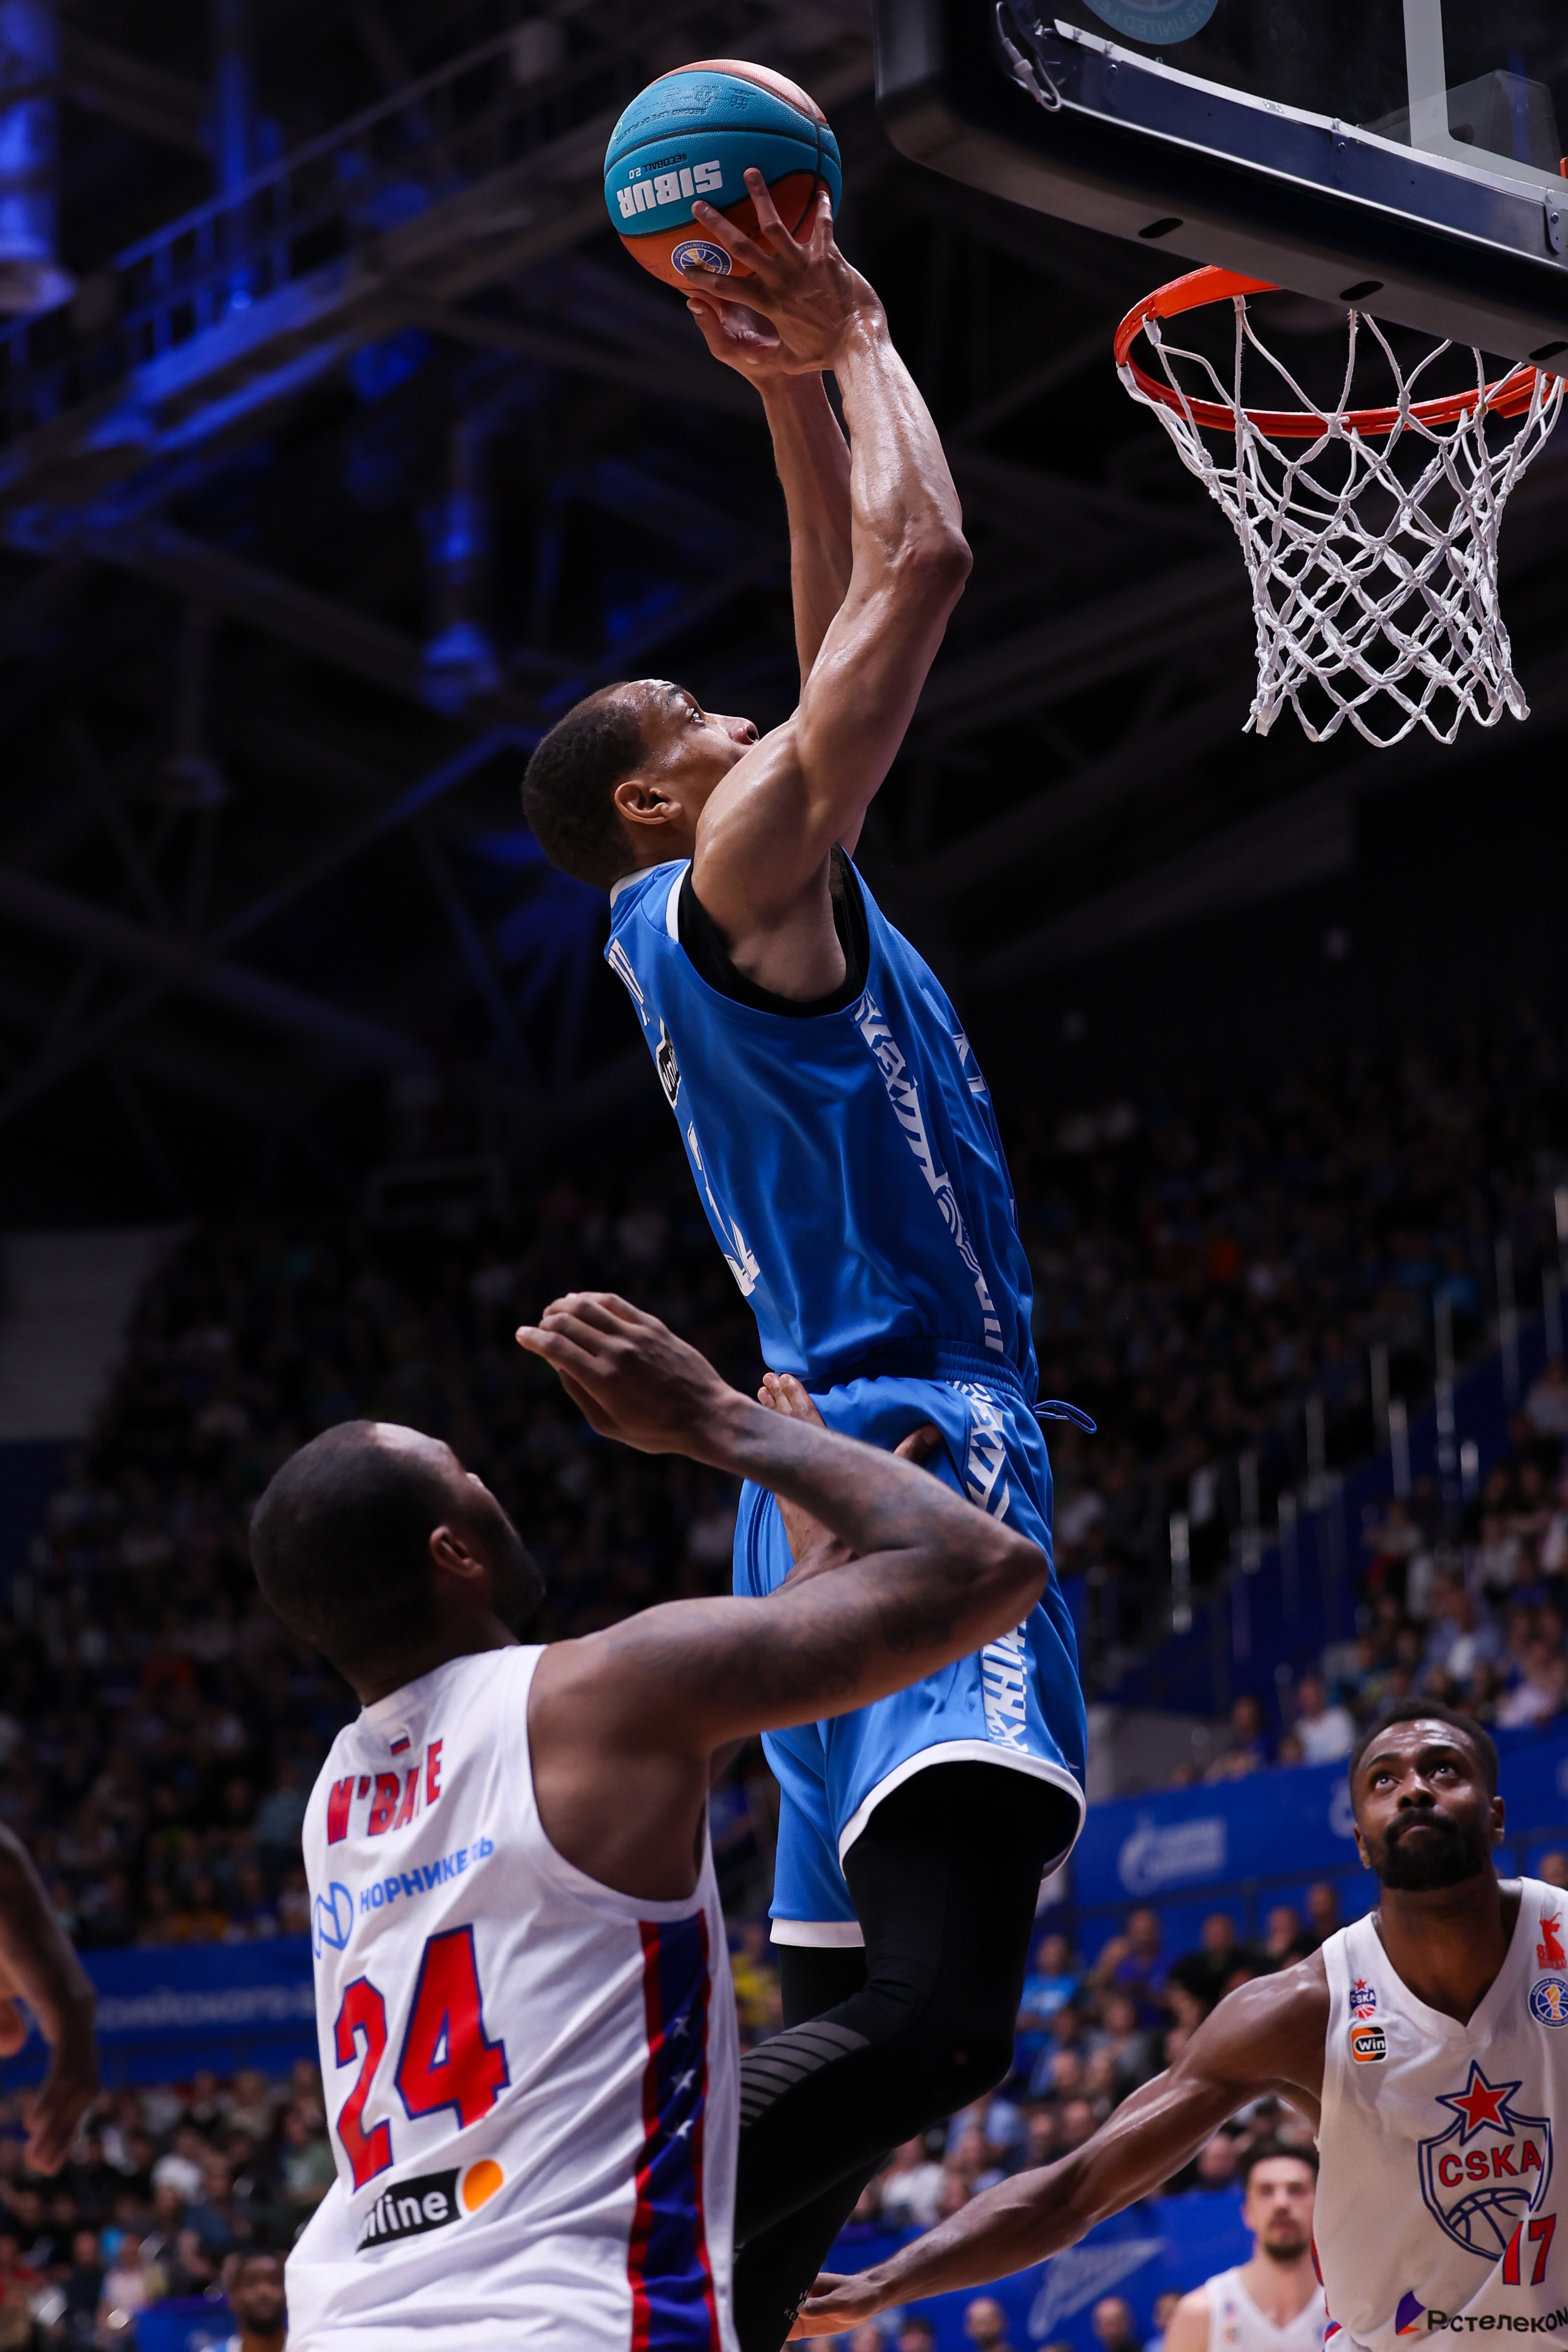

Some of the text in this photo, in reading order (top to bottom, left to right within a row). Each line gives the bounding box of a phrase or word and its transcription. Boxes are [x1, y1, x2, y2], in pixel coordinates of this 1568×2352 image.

[616, 160, 723, 219] SIBUR
[628, 156, 687, 179] #ECOBALL 2.0
[328, 1738, 443, 1846] M'BAE
[1351, 1992, 1376, 2004] CSKA
[334, 1923, 510, 2194] 24
[1358, 2038, 1385, 2051] Win
[1439, 2140, 1542, 2187] CSKA
[1502, 2212, 1557, 2286] 17
